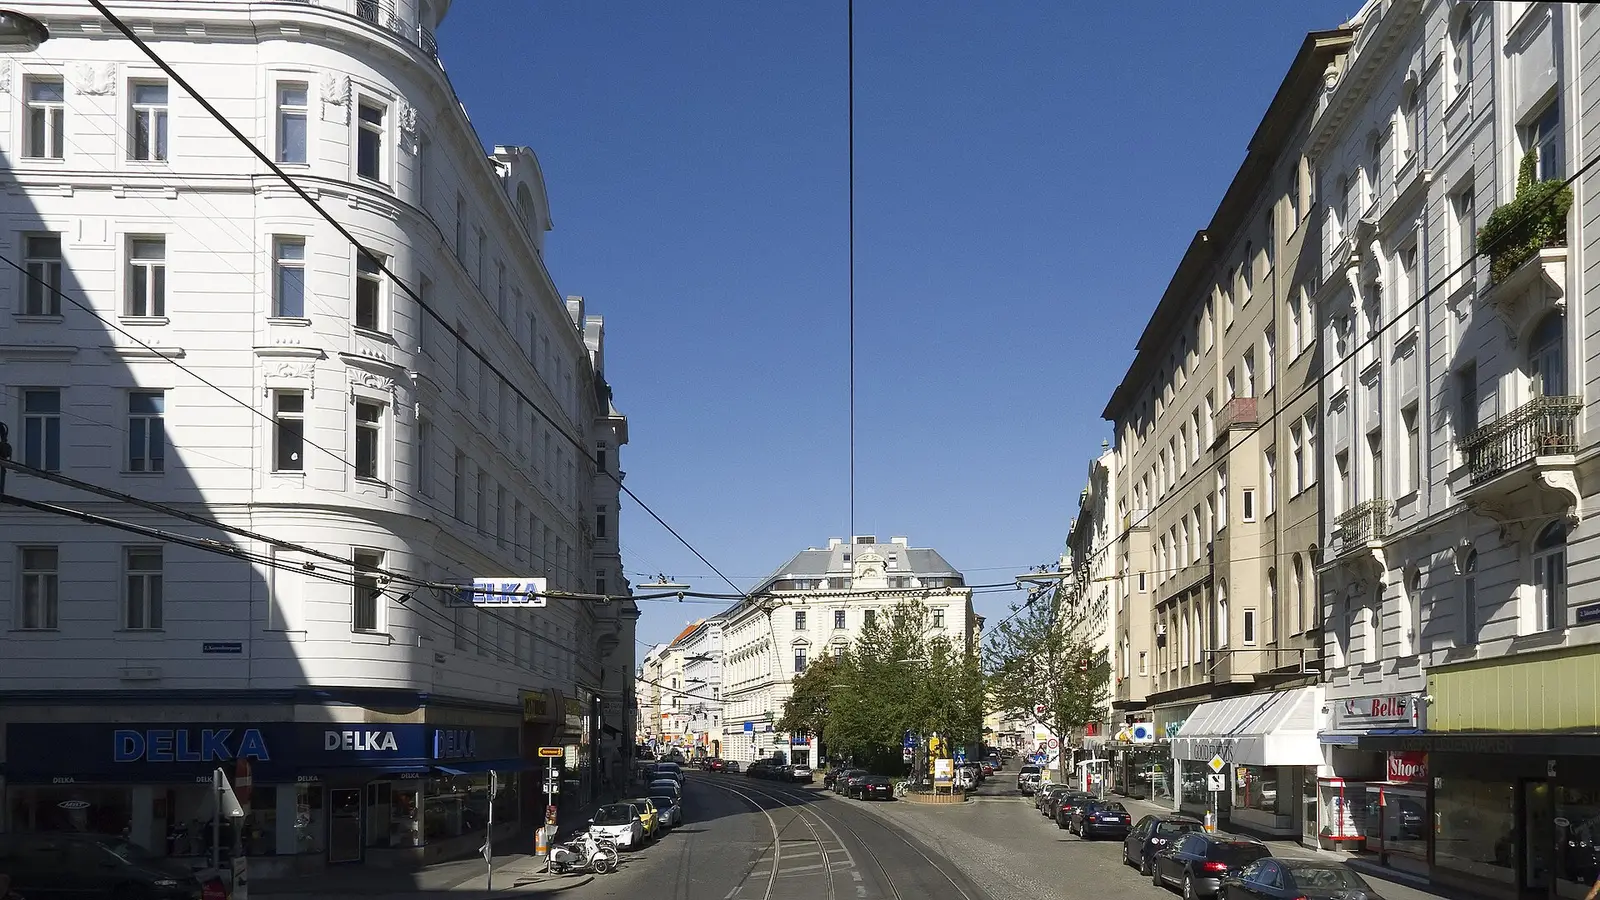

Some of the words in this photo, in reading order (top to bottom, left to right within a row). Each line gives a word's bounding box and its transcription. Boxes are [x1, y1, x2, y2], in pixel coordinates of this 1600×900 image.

[114, 729, 270, 762] DELKA
[324, 730, 398, 751] DELKA
[434, 729, 475, 759] DELKA
[1390, 758, 1425, 777] Shoes
